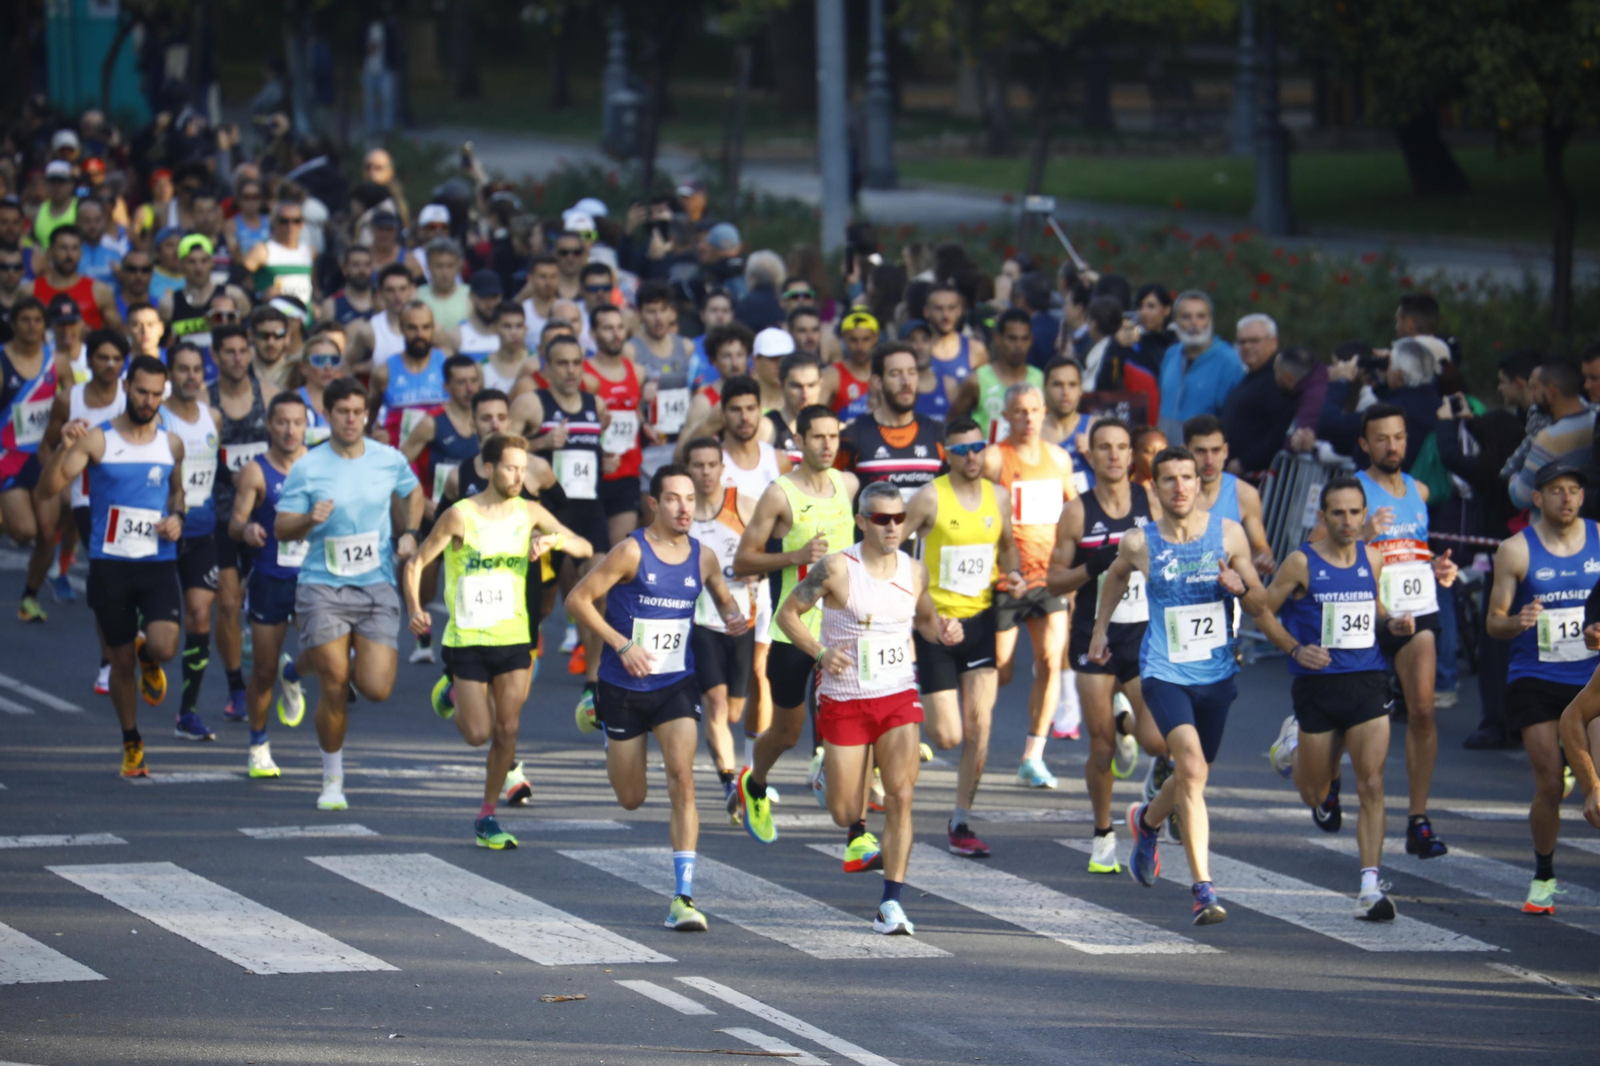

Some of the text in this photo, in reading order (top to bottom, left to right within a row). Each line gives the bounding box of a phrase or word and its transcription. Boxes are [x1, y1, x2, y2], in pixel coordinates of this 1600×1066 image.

[189, 470, 212, 486] 427
[573, 462, 589, 477] 84
[123, 517, 153, 537] 342
[343, 544, 373, 562] 124
[957, 558, 984, 574] 429
[1403, 578, 1422, 595] 60
[475, 589, 503, 604] 434
[1313, 590, 1374, 603] TROTASIERRA
[1190, 617, 1214, 636] 72
[1341, 613, 1370, 631] 349
[652, 633, 681, 650] 128
[877, 646, 904, 665] 133
